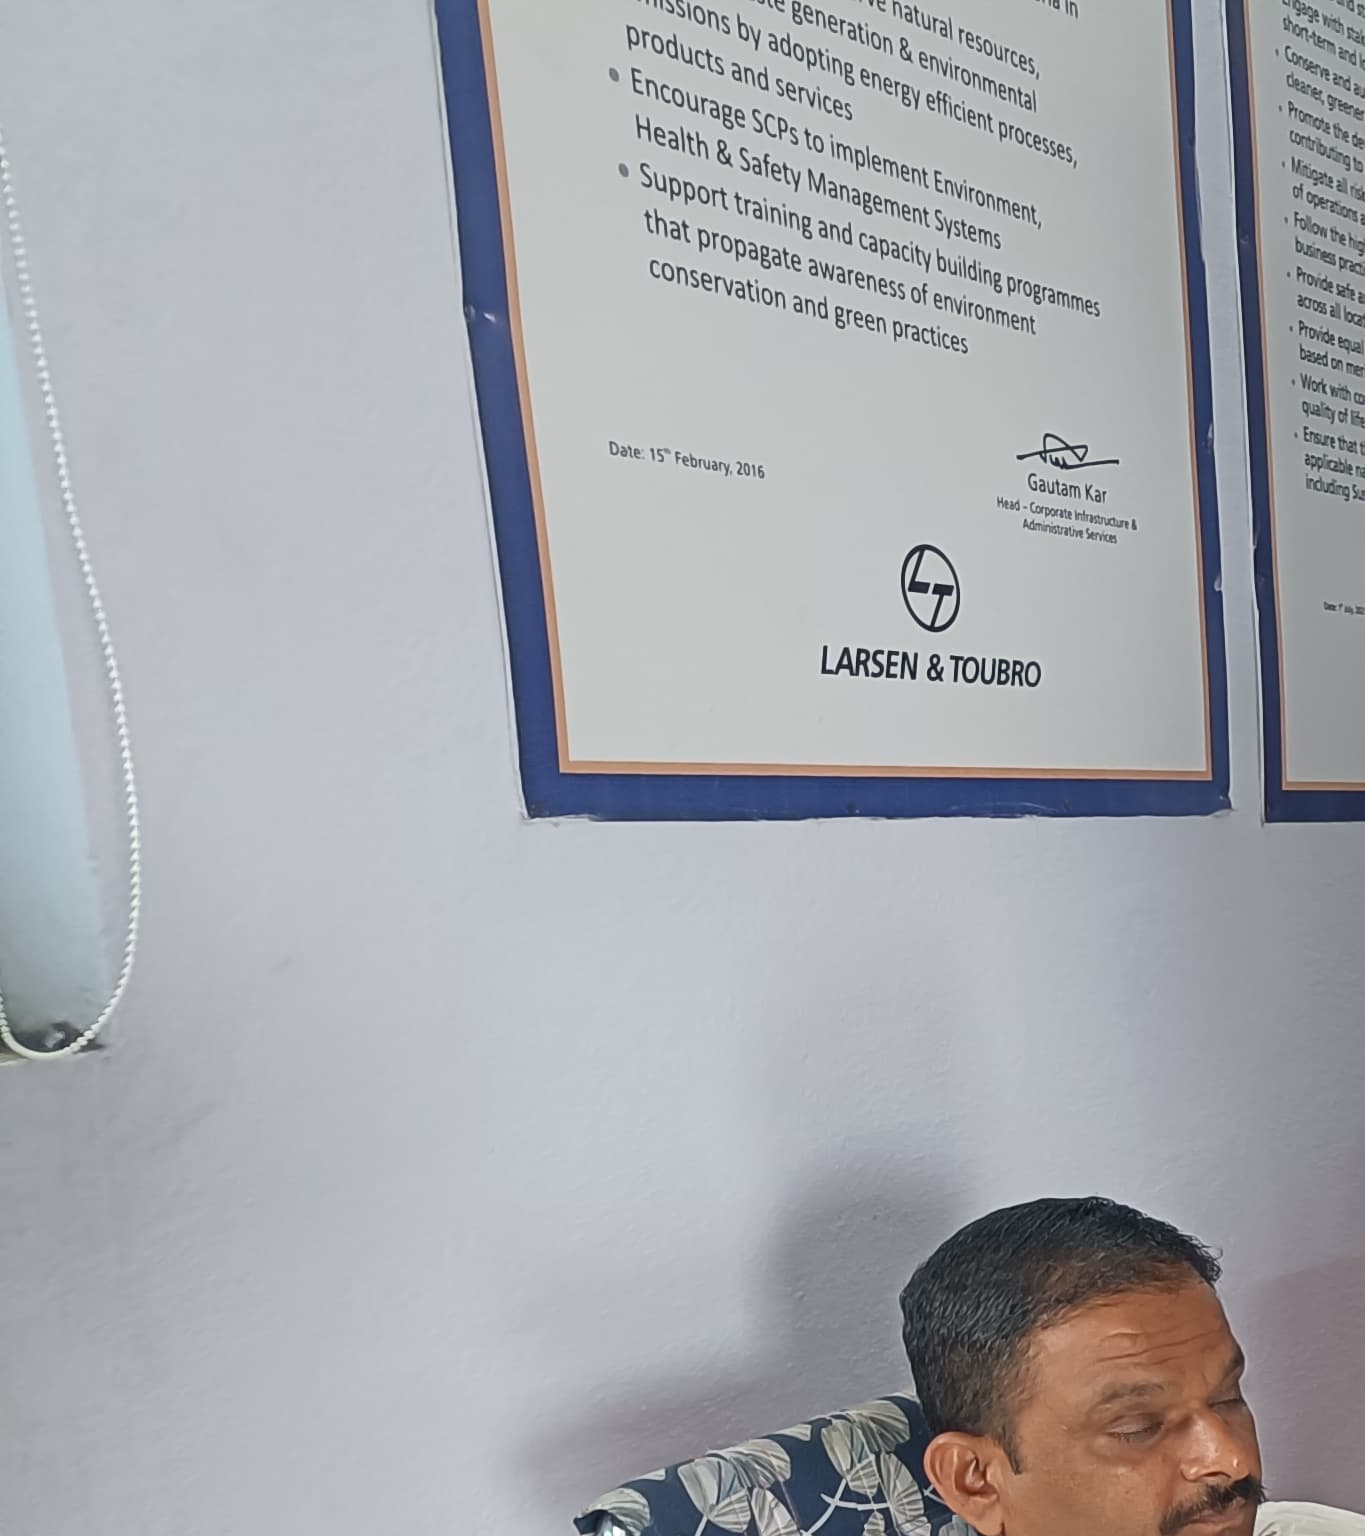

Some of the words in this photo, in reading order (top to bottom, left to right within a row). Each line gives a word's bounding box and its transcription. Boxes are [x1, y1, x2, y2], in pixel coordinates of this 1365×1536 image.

[792, 1, 893, 55] generation
[900, 37, 913, 63] &
[919, 49, 1037, 112] environmental
[893, 0, 953, 40] natural
[958, 26, 1040, 80] resources,
[1338, 46, 1357, 66] and
[625, 24, 725, 76] products
[731, 62, 770, 91] and
[775, 77, 853, 121] services
[638, 0, 731, 34] ssions
[737, 13, 761, 51] by
[768, 32, 855, 86] adopting
[860, 68, 921, 110] energy
[926, 90, 994, 134] efficient
[998, 120, 1078, 168] processes,
[1284, 45, 1330, 82] Conserve
[1332, 73, 1351, 92] and
[1288, 100, 1331, 135] Promote
[1333, 122, 1349, 143] the
[630, 67, 746, 130] Encourage
[752, 108, 800, 146] SCPs
[804, 127, 824, 153] to
[829, 134, 929, 189] implement
[934, 170, 1042, 230] Environment,
[1289, 130, 1350, 171] contributing
[1353, 156, 1364, 173] to
[635, 114, 709, 160] Health
[716, 139, 734, 168] &
[739, 147, 801, 192] Safety
[807, 168, 930, 228] Management
[934, 209, 1002, 250] Systems
[1291, 156, 1334, 189] Mitigate
[1336, 177, 1348, 194] all
[1292, 183, 1303, 200] of
[1306, 191, 1358, 223] operations
[640, 162, 729, 211] Support
[733, 192, 813, 240] training
[818, 220, 852, 246] and
[858, 232, 932, 274] capacity
[936, 248, 1002, 294] building
[1007, 274, 1101, 318] programmes
[1294, 211, 1328, 238] Follow
[1330, 226, 1346, 246] the
[1295, 235, 1336, 266] business
[643, 208, 691, 244] that
[697, 228, 802, 273] propagate
[808, 258, 906, 302] awareness
[910, 282, 928, 305] of
[933, 290, 1036, 336] environment
[1296, 266, 1333, 294] Provide
[1336, 283, 1355, 301] safe
[649, 258, 786, 310] conservation
[793, 295, 828, 320] and
[834, 305, 887, 335] green
[893, 317, 969, 354] practices
[1297, 294, 1327, 315] across
[1330, 302, 1341, 320] all
[1298, 319, 1335, 346] Provide
[1337, 336, 1364, 355] equal
[1299, 342, 1328, 367] based
[1331, 357, 1343, 372] on
[1300, 372, 1328, 395] Work
[1329, 383, 1352, 401] with
[1302, 400, 1336, 424] quality
[1337, 407, 1348, 424] of
[1303, 425, 1336, 449] Ensure
[1337, 434, 1358, 456] that
[608, 441, 645, 460] Date:
[674, 451, 733, 477] February,
[736, 461, 765, 479] 2016
[1304, 453, 1353, 476] applicable
[1027, 473, 1081, 499] Gautam
[1085, 483, 1107, 504] Kar
[1305, 473, 1350, 501] including
[996, 496, 1020, 511] Head
[1030, 502, 1072, 520] Corporate
[1075, 509, 1129, 530] Infrastructure
[1131, 518, 1137, 531] &
[1023, 518, 1083, 539] Administrative
[1086, 528, 1118, 544] Services
[820, 645, 918, 681] LARSEN
[926, 653, 945, 682] &
[950, 655, 1041, 688] TOUBRO
